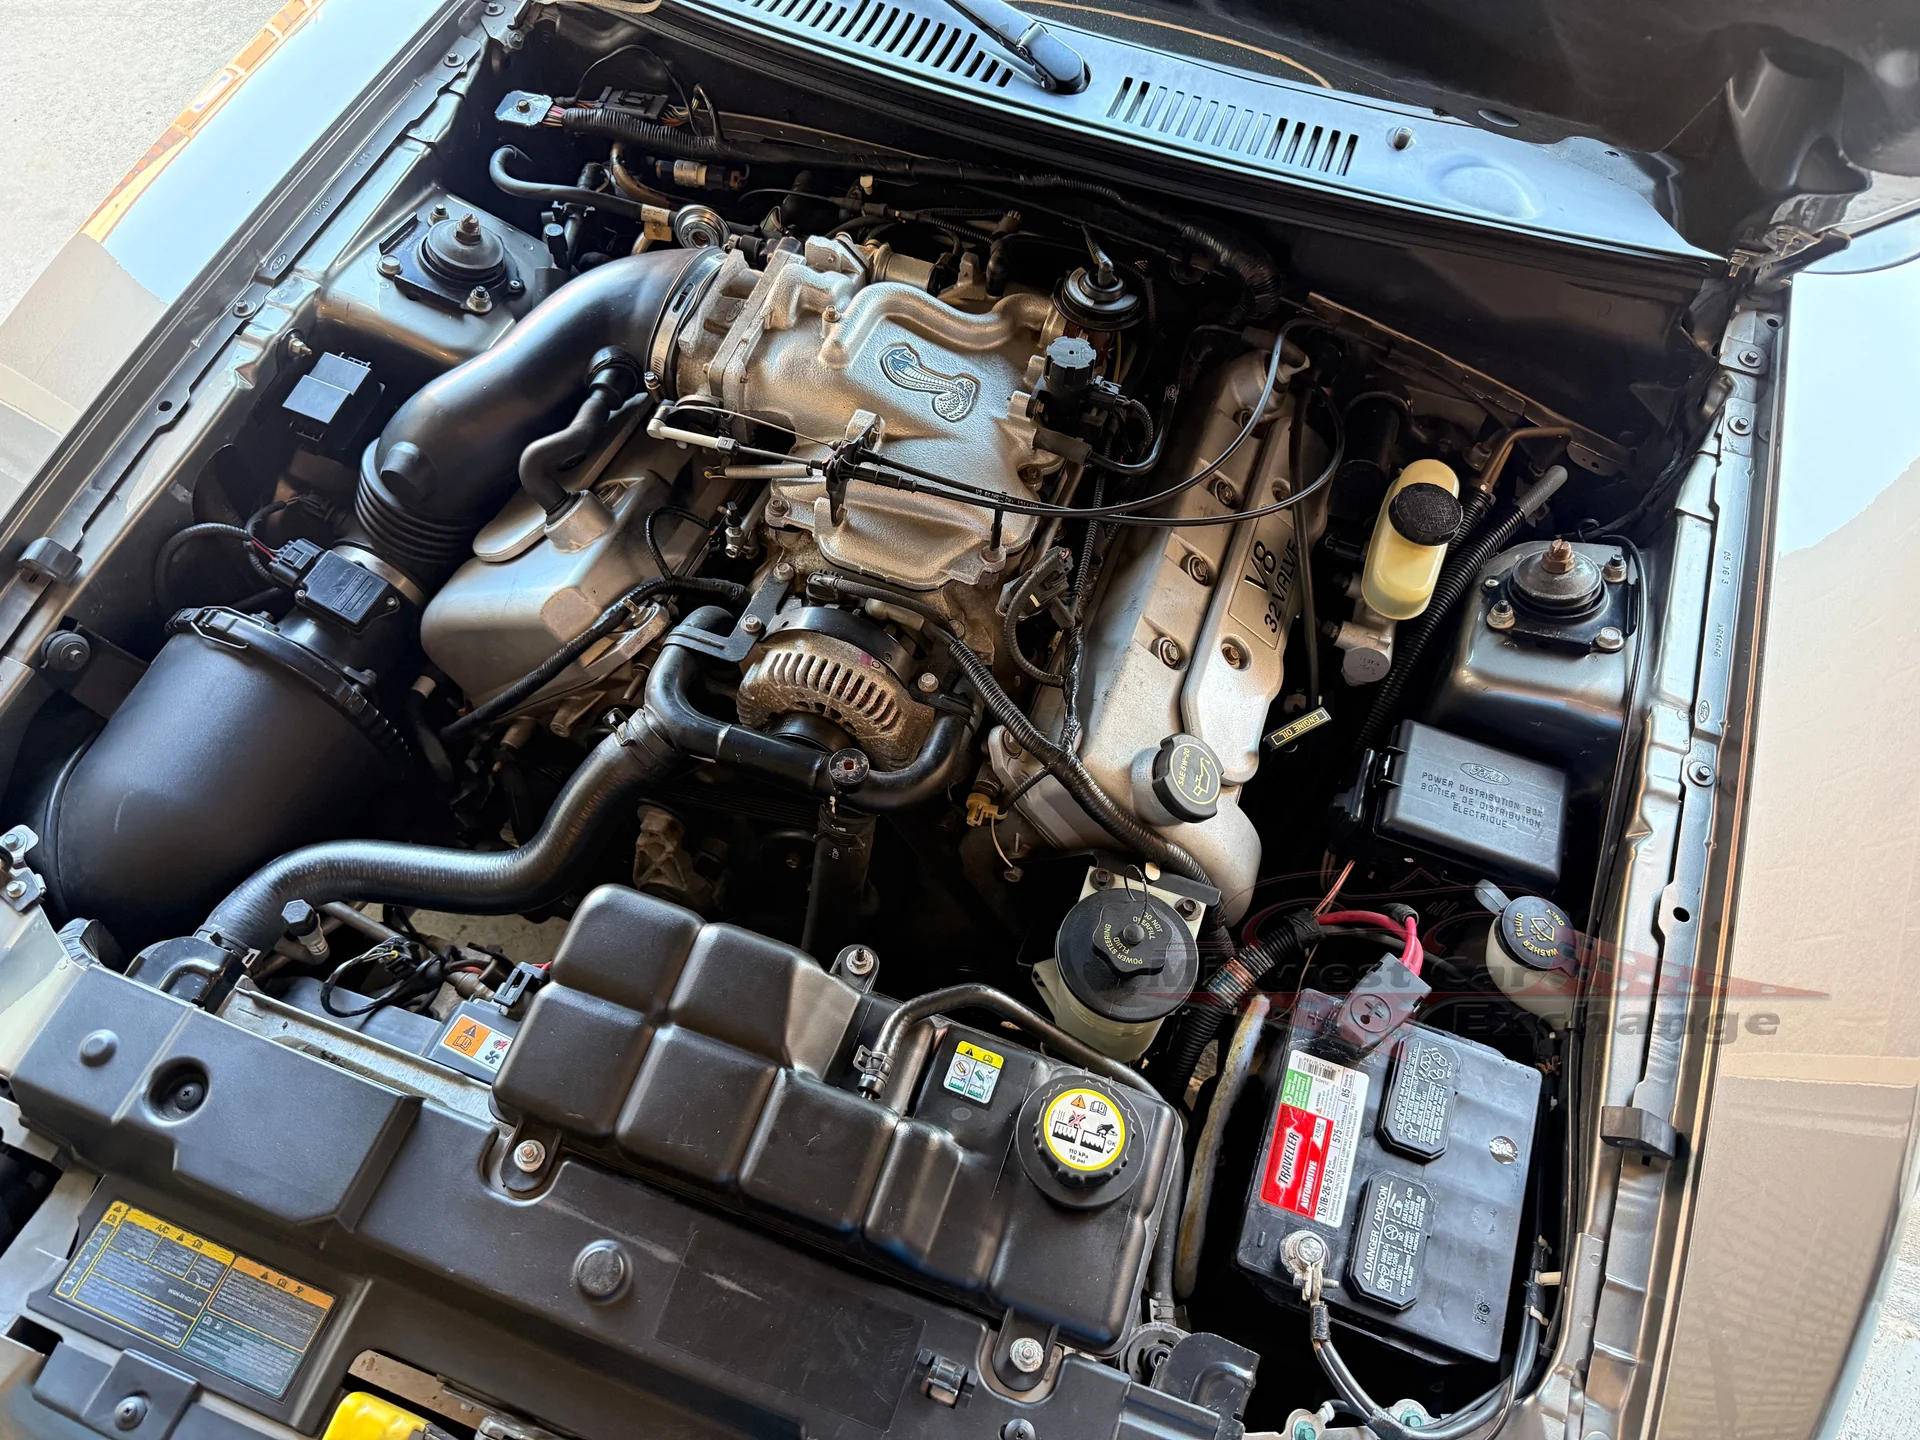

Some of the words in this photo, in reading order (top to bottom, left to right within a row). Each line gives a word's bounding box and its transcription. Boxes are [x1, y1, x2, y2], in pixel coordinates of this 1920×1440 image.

[1244, 541, 1276, 592] V8
[1264, 601, 1282, 633] 32
[1279, 728, 1293, 739] OIL
[1292, 714, 1320, 732] ENGINE
[1180, 748, 1190, 771] 5W-20
[1178, 770, 1186, 786] SAE
[1467, 763, 1505, 784] Ford
[1421, 782, 1456, 800] BOÎTIER
[1462, 796, 1474, 806] DE
[1480, 802, 1541, 828] DISTRIBUTION
[1422, 772, 1454, 788] POWER
[1460, 784, 1520, 810] DISTRIBUTION
[1526, 804, 1543, 818] BOX
[1144, 912, 1152, 922] DO
[1152, 918, 1163, 934] NOT
[1514, 912, 1524, 938] FLUID
[1546, 908, 1565, 926] ONLY
[1104, 923, 1118, 955] STEERING
[1113, 936, 1130, 954] FLUID
[1522, 940, 1559, 957] WASHER
[1117, 952, 1143, 965] POWER
[1341, 1087, 1350, 1097] 85
[1333, 1128, 1342, 1142] 575
[1078, 1150, 1088, 1159] kPa
[1279, 1133, 1299, 1185] TRAVELLER
[1302, 1161, 1317, 1209] AUTOMOTIVE
[1317, 1170, 1334, 1217] TS/IB-26-575
[156, 1224, 170, 1236] A/C
[1365, 1232, 1379, 1270] DANGER
[1375, 1186, 1388, 1221] POISON
[1398, 1232, 1404, 1241] NO
[1390, 1253, 1399, 1278] EXPLOSIVE
